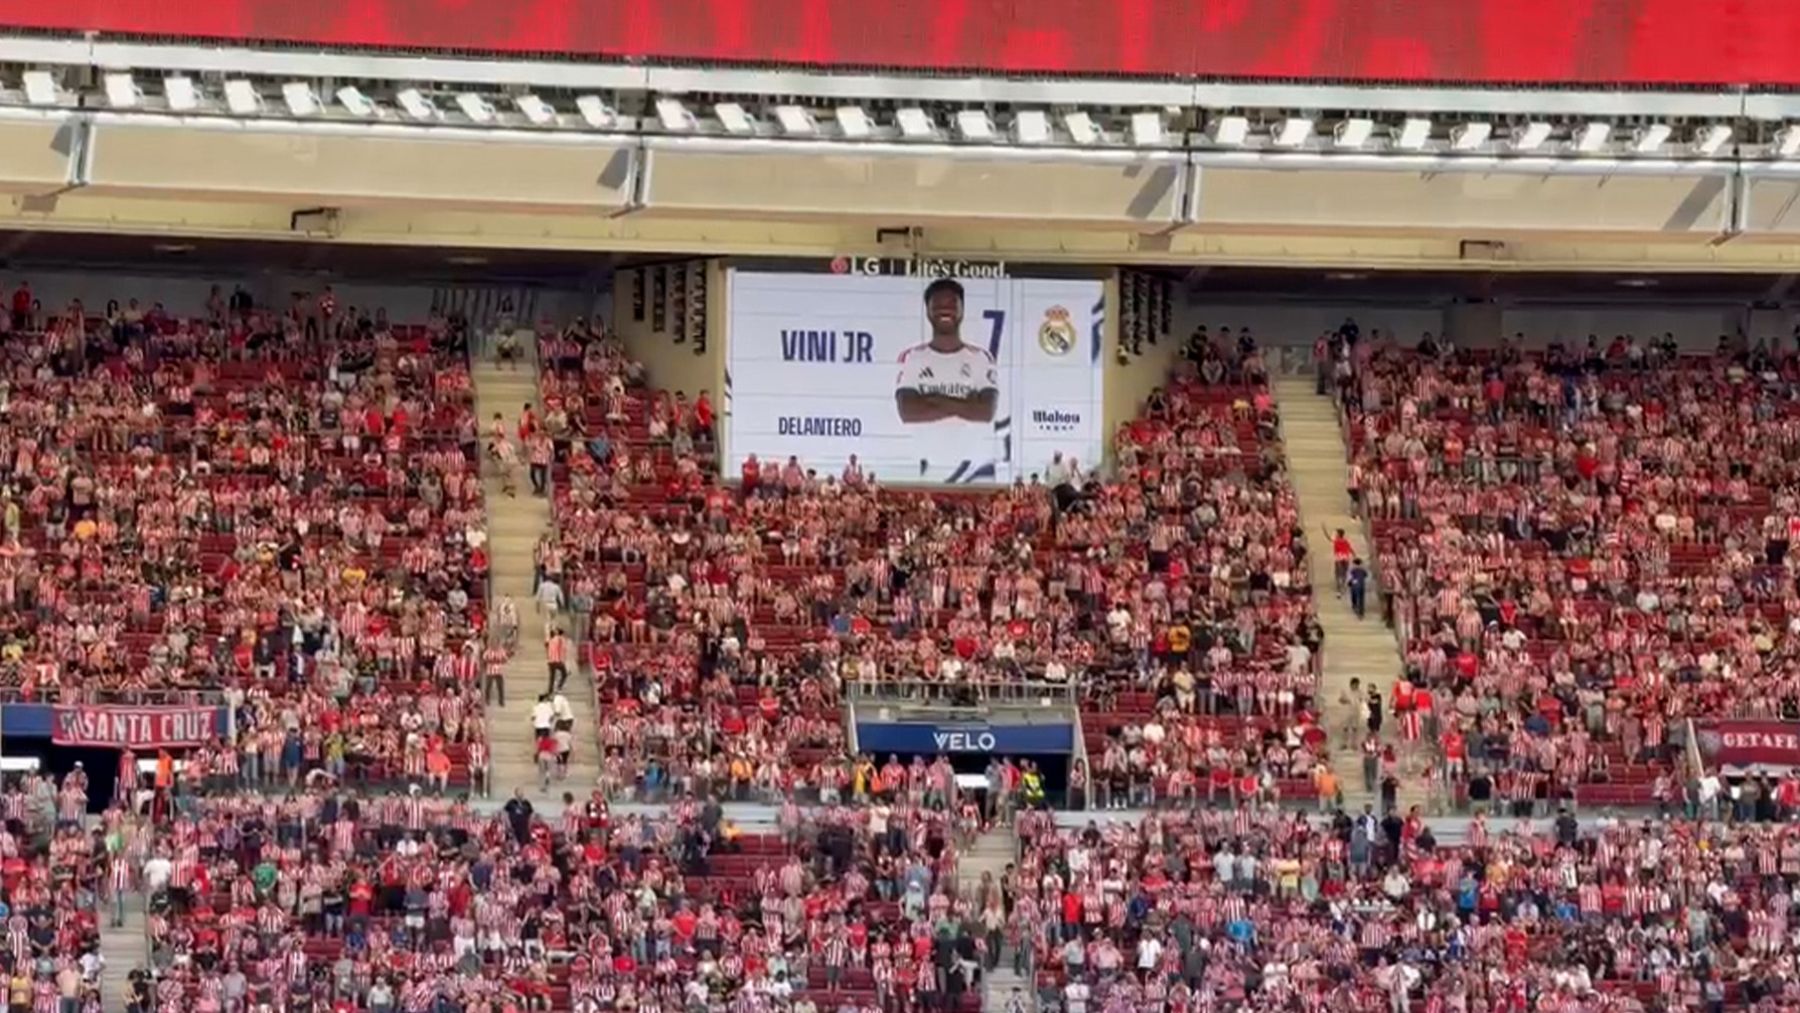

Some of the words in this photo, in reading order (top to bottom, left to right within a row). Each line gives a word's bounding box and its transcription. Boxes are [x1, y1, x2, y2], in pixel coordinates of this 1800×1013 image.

[851, 257, 880, 276] LG
[781, 329, 836, 362] VINI
[843, 331, 874, 363] JR
[982, 310, 1005, 362] 7
[778, 416, 862, 437] DELANTERO
[83, 711, 152, 742] SANTA
[160, 711, 211, 741] CRUZ
[933, 732, 996, 751] VELO
[1723, 732, 1798, 749] GETAFE
